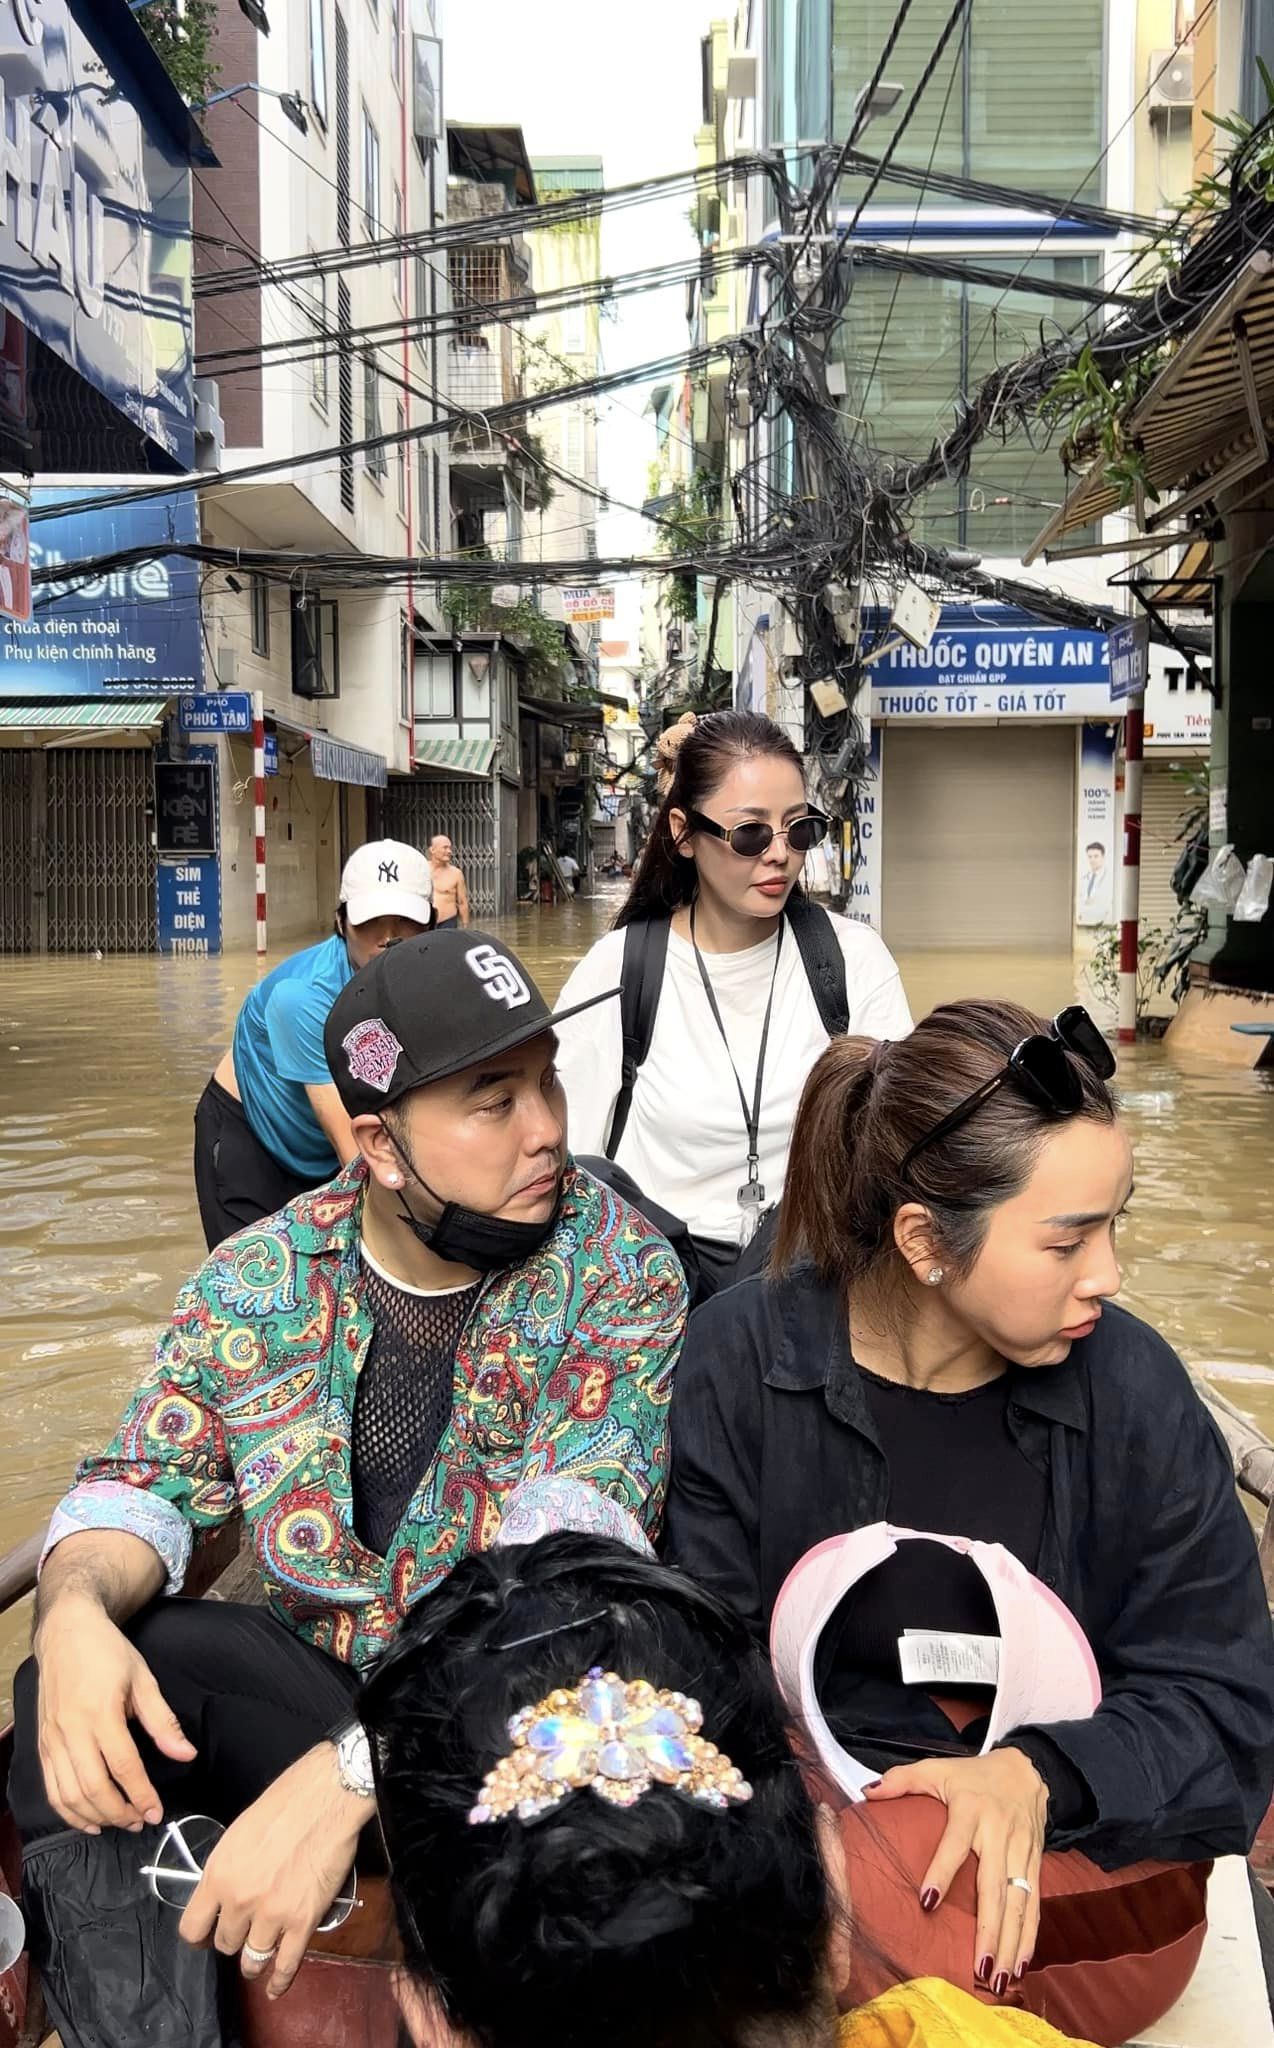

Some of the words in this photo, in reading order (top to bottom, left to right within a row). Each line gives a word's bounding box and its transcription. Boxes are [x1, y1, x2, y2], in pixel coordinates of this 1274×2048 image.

[45, 619, 78, 637] điện
[82, 619, 120, 637] thoại
[5, 645, 33, 663] Phụ
[37, 645, 69, 663] kiện
[73, 645, 114, 660] chính
[117, 645, 157, 663] hãng
[889, 636, 967, 669] THUỐC
[975, 637, 1053, 670] QUYÊN
[1061, 642, 1093, 666] AN
[989, 674, 1006, 684] GPP
[879, 689, 938, 713] THUỐC
[945, 688, 978, 712] TỐT
[1033, 688, 1066, 711] TỐT
[184, 708, 218, 726] PHÚC
[221, 709, 246, 726] TÂN
[175, 867, 201, 882] SIM
[176, 886, 201, 906] THẺ
[174, 913, 205, 932] ĐIỆN
